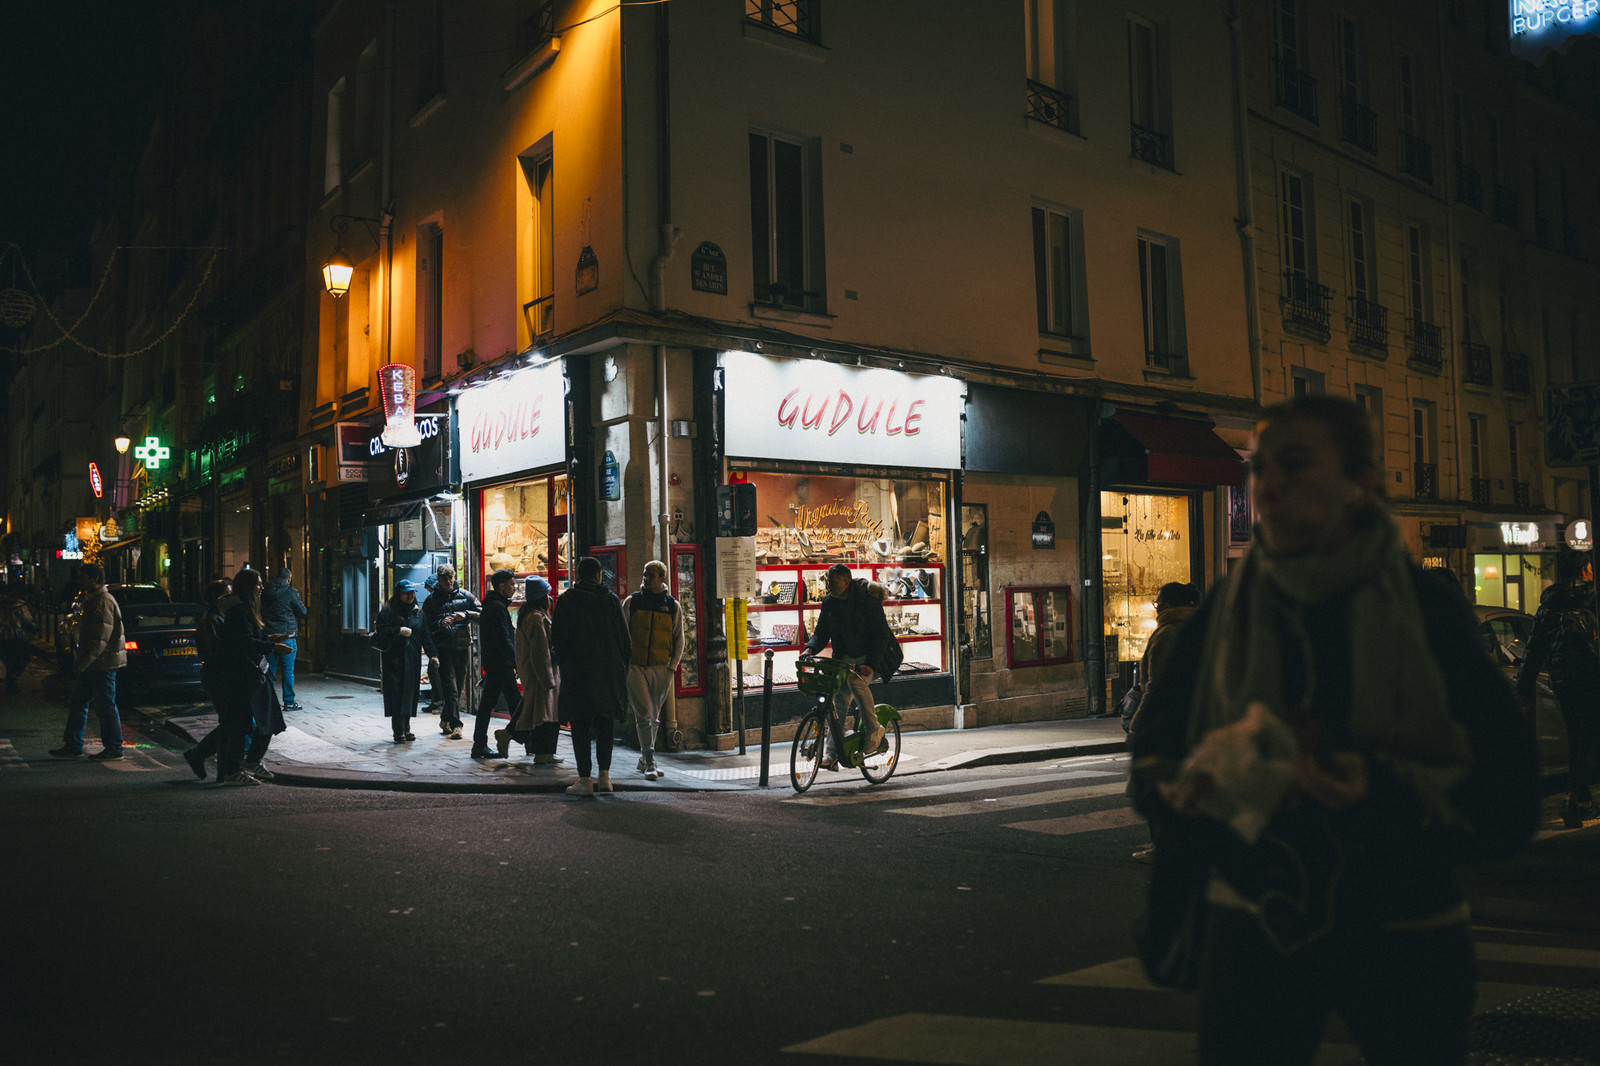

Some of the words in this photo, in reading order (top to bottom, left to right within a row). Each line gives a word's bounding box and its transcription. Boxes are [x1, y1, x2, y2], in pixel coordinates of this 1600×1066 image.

[1513, 0, 1598, 35] BURGER
[470, 394, 543, 454] GUDULE
[777, 387, 926, 437] GUDULE
